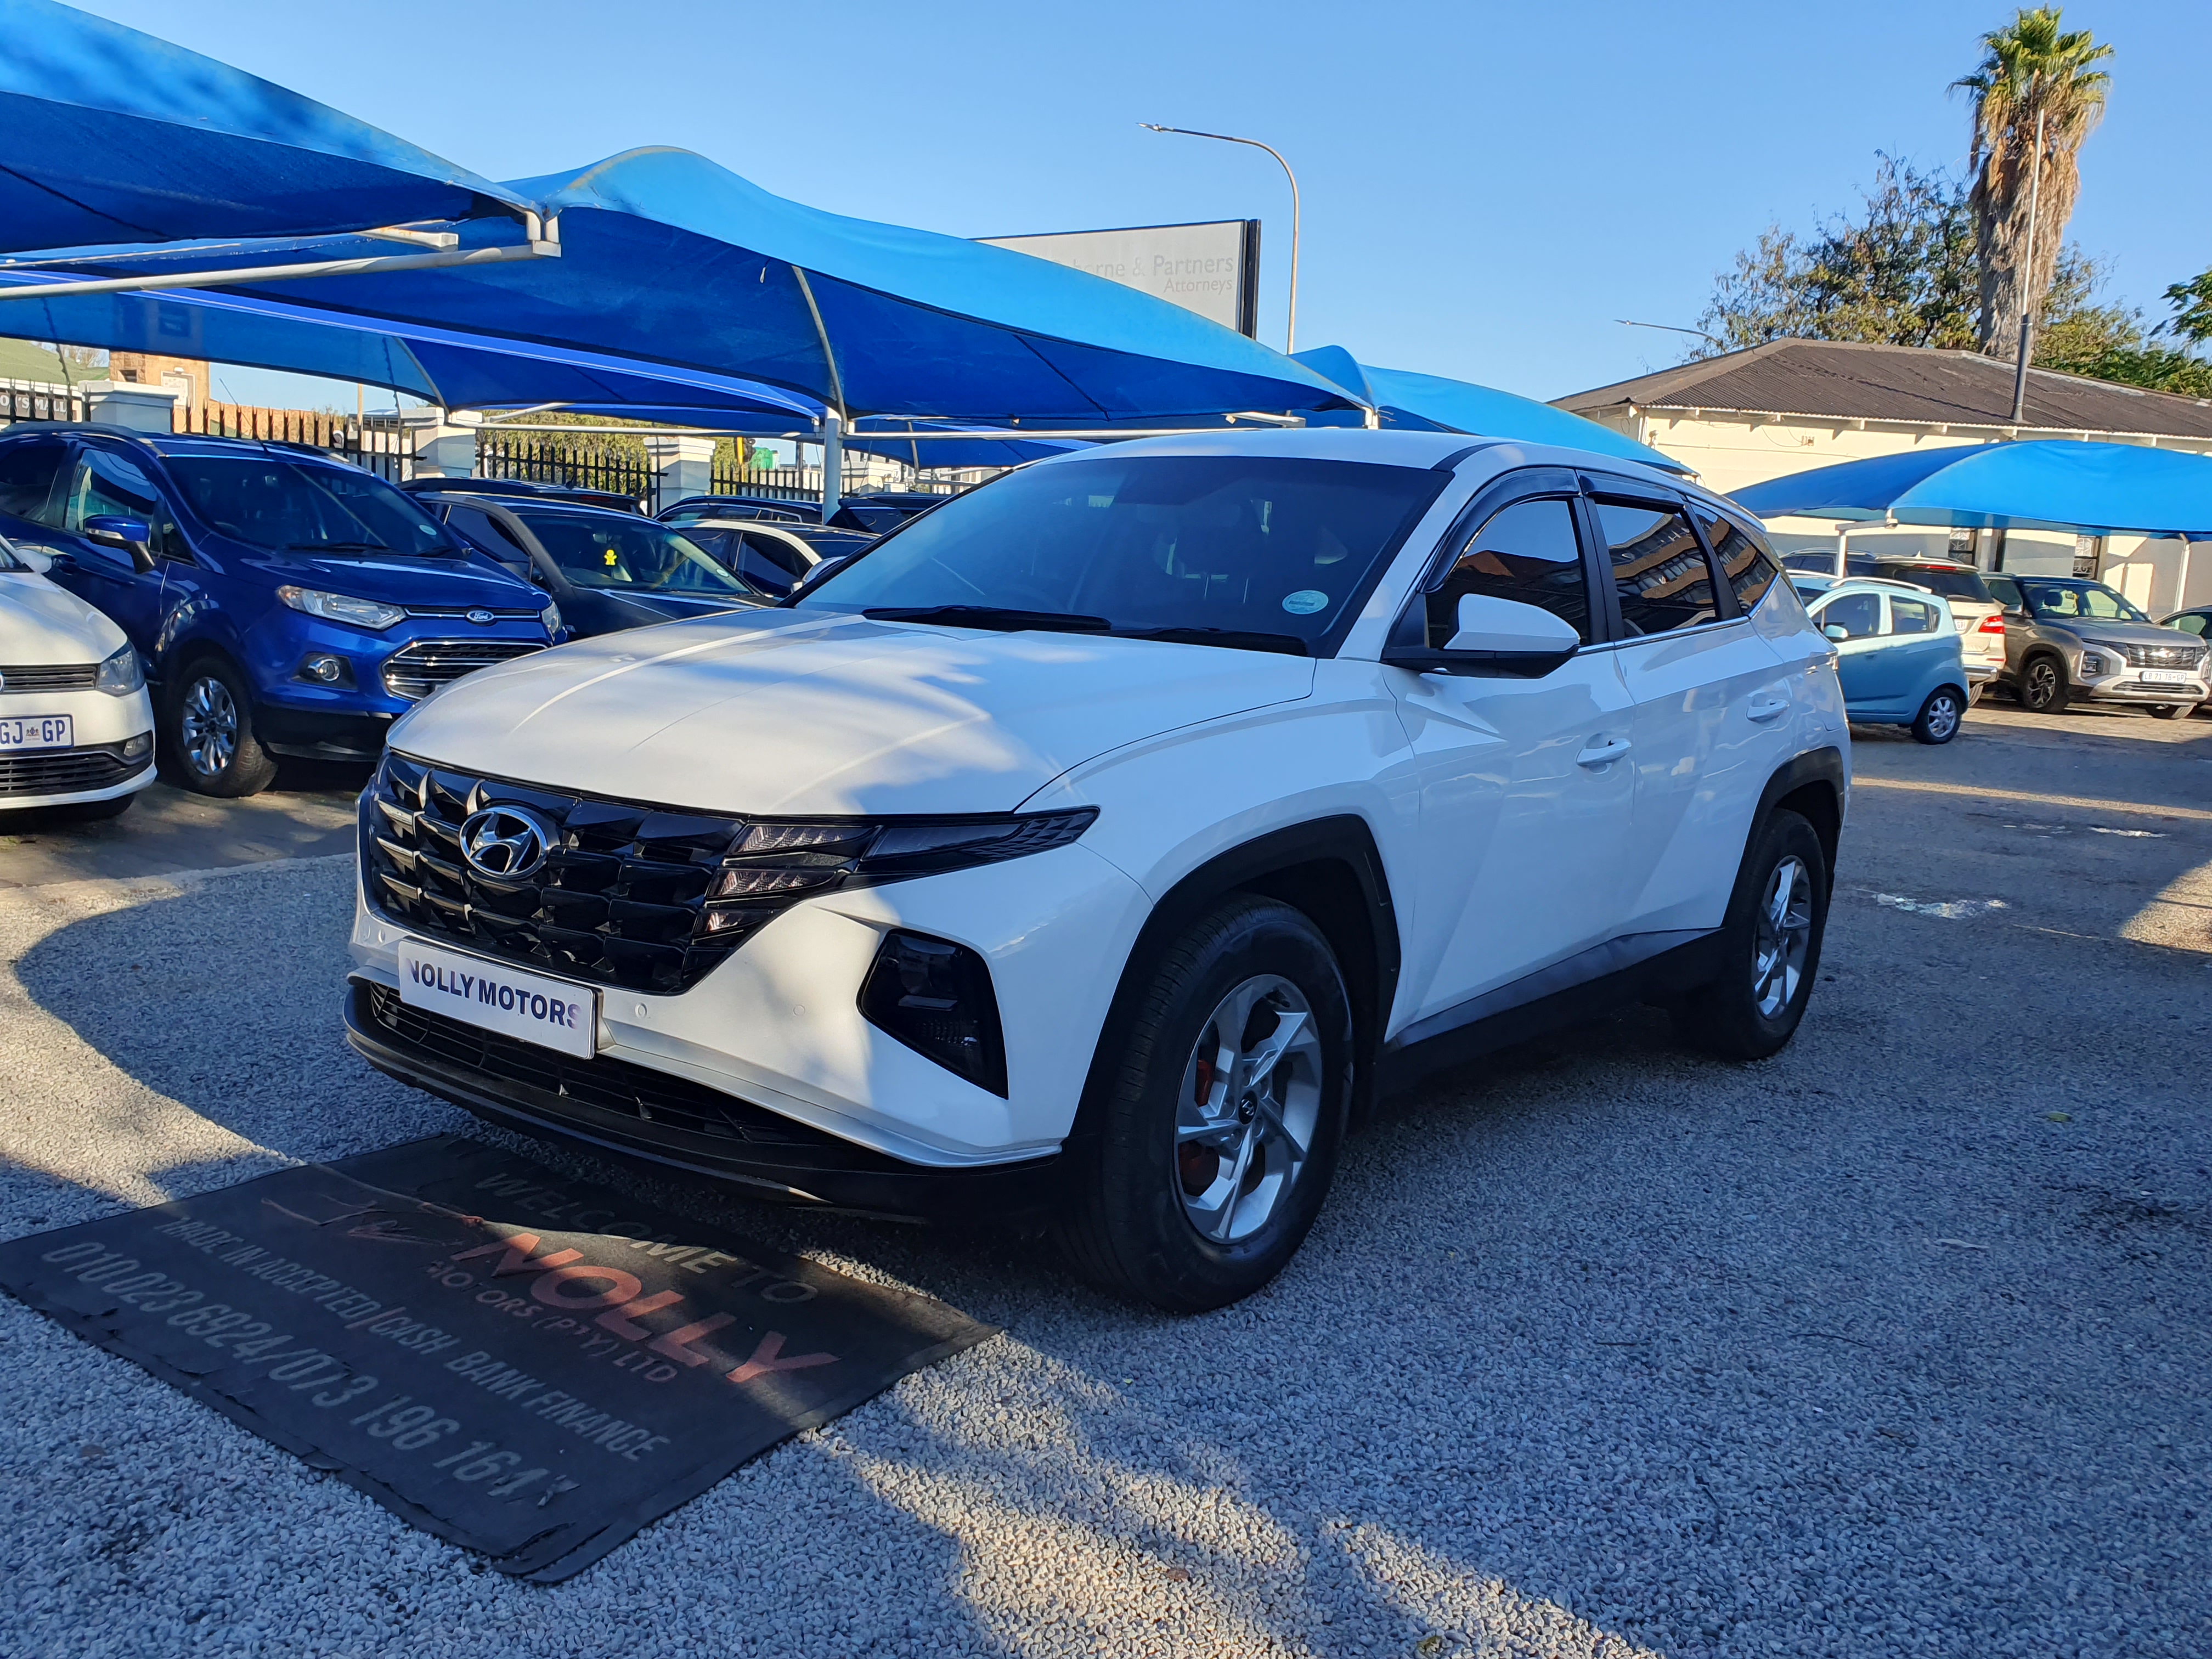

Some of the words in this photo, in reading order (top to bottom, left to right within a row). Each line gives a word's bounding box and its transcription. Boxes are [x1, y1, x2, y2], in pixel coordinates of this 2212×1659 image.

[1132, 256, 1146, 277] &
[1153, 255, 1234, 275] Partners
[1163, 277, 1233, 295] Attorneys
[42, 719, 65, 742] GP
[478, 979, 582, 1030] MOTORS
[475, 1172, 738, 1274] WELCOME
[731, 1264, 819, 1304] TO
[450, 1232, 842, 1383] NOLLY
[219, 1244, 270, 1267] IN
[443, 1351, 548, 1400] BANK
[521, 1389, 672, 1462] FINANCE
[612, 1350, 678, 1383] LTD
[349, 1395, 460, 1451] 196
